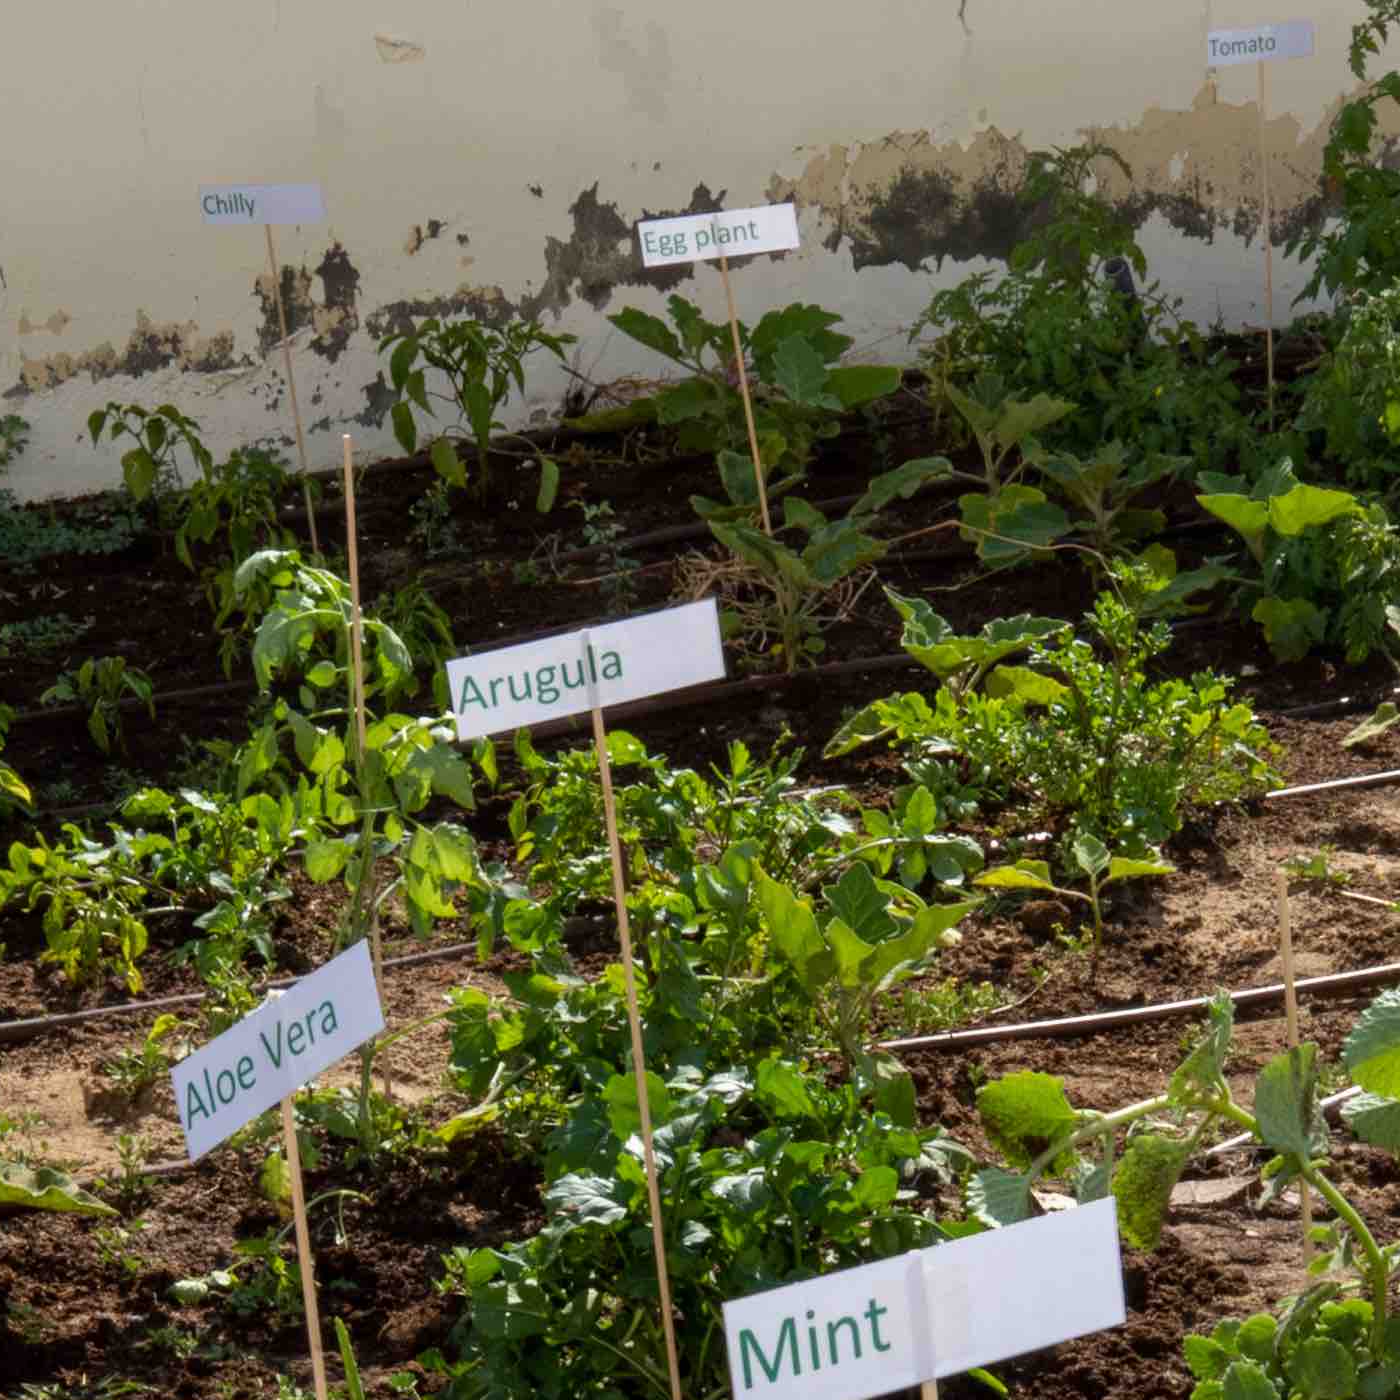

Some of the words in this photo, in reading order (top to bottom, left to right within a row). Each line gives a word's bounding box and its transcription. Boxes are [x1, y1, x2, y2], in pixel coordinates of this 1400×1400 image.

[1209, 36, 1277, 57] Tomato
[202, 192, 255, 218] Chilly
[643, 230, 689, 257] Egg
[696, 219, 760, 252] plant
[458, 643, 624, 716] Arugula
[186, 1055, 257, 1131] Aloe
[260, 999, 338, 1070] Vera
[738, 1298, 891, 1390] Mint
